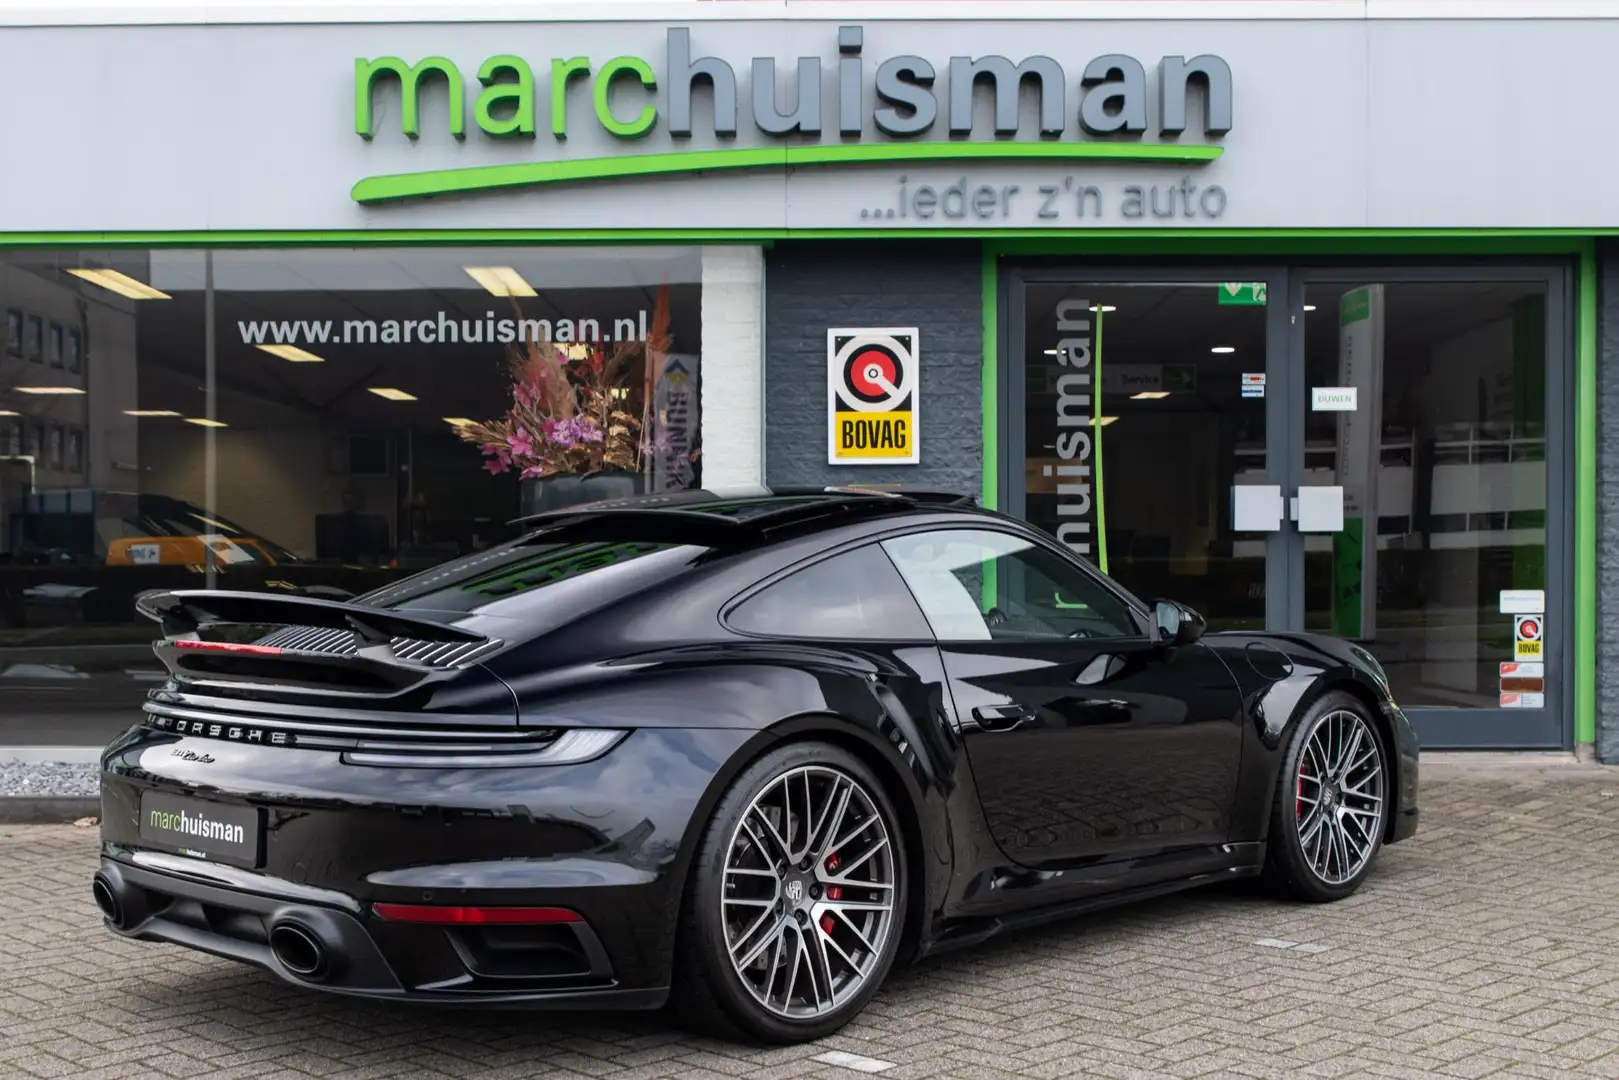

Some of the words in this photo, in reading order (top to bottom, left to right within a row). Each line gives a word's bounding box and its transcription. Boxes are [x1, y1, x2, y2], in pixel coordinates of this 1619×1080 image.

[354, 25, 1233, 139] marchuisman
[1037, 177, 1102, 219] z'n
[1121, 177, 1227, 219] auto
[238, 310, 648, 344] www.marchuisman.nl
[842, 420, 906, 449] BOVAG
[1518, 643, 1540, 653] BOVAG
[150, 809, 244, 844] marchuisman
